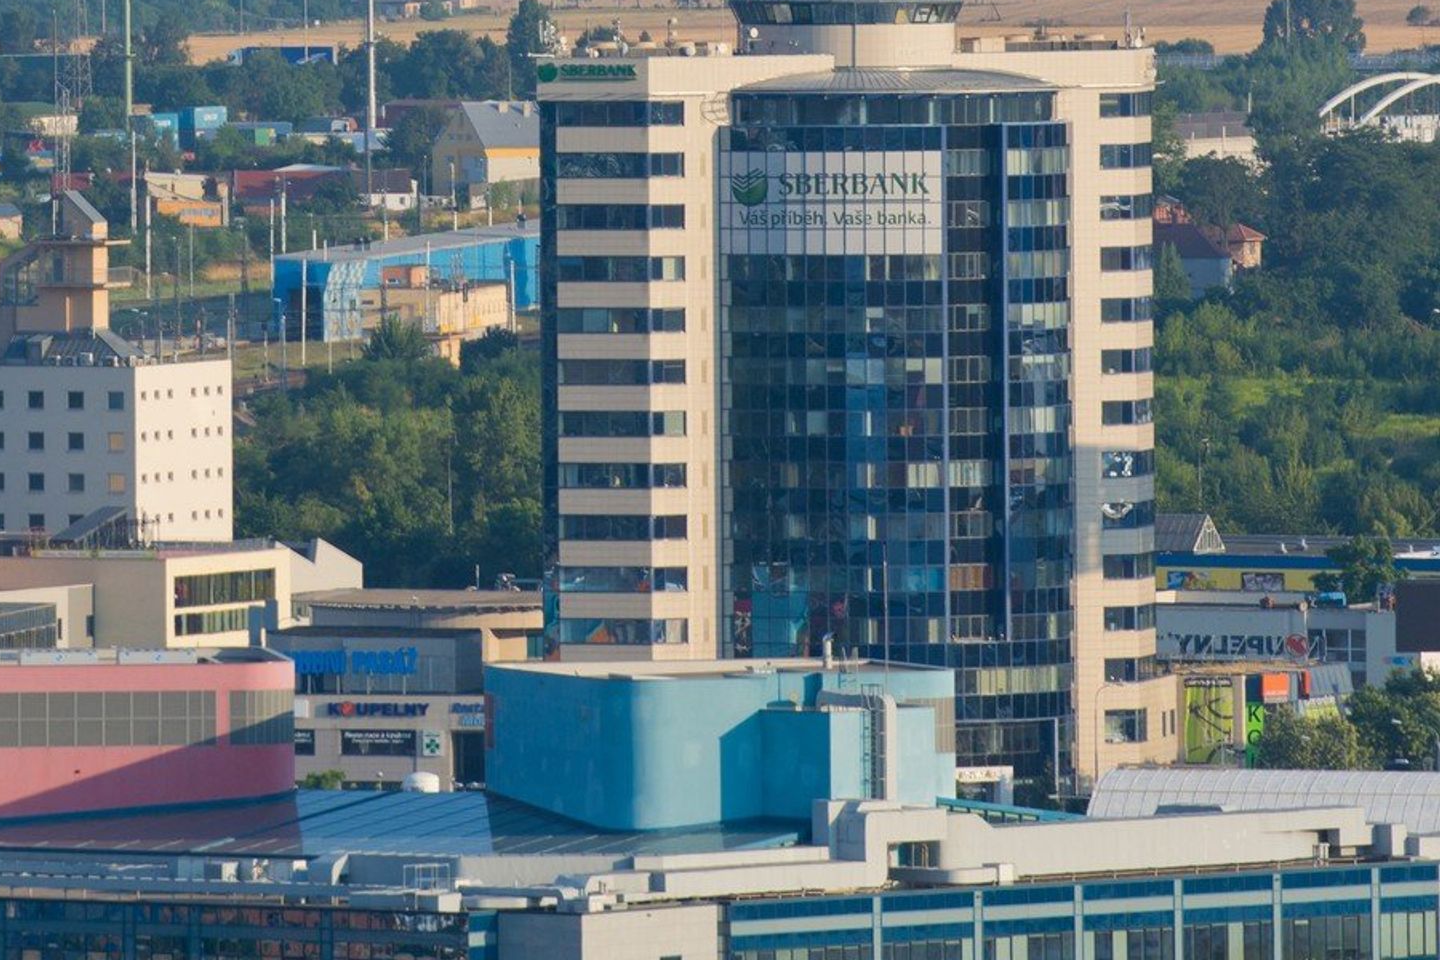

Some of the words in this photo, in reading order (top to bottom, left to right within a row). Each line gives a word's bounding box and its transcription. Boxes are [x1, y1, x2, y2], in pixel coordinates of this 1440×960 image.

[560, 63, 637, 77] SBERBANK
[777, 171, 929, 196] SBERBANK
[833, 210, 873, 225] Vaše
[877, 209, 932, 225] banka.
